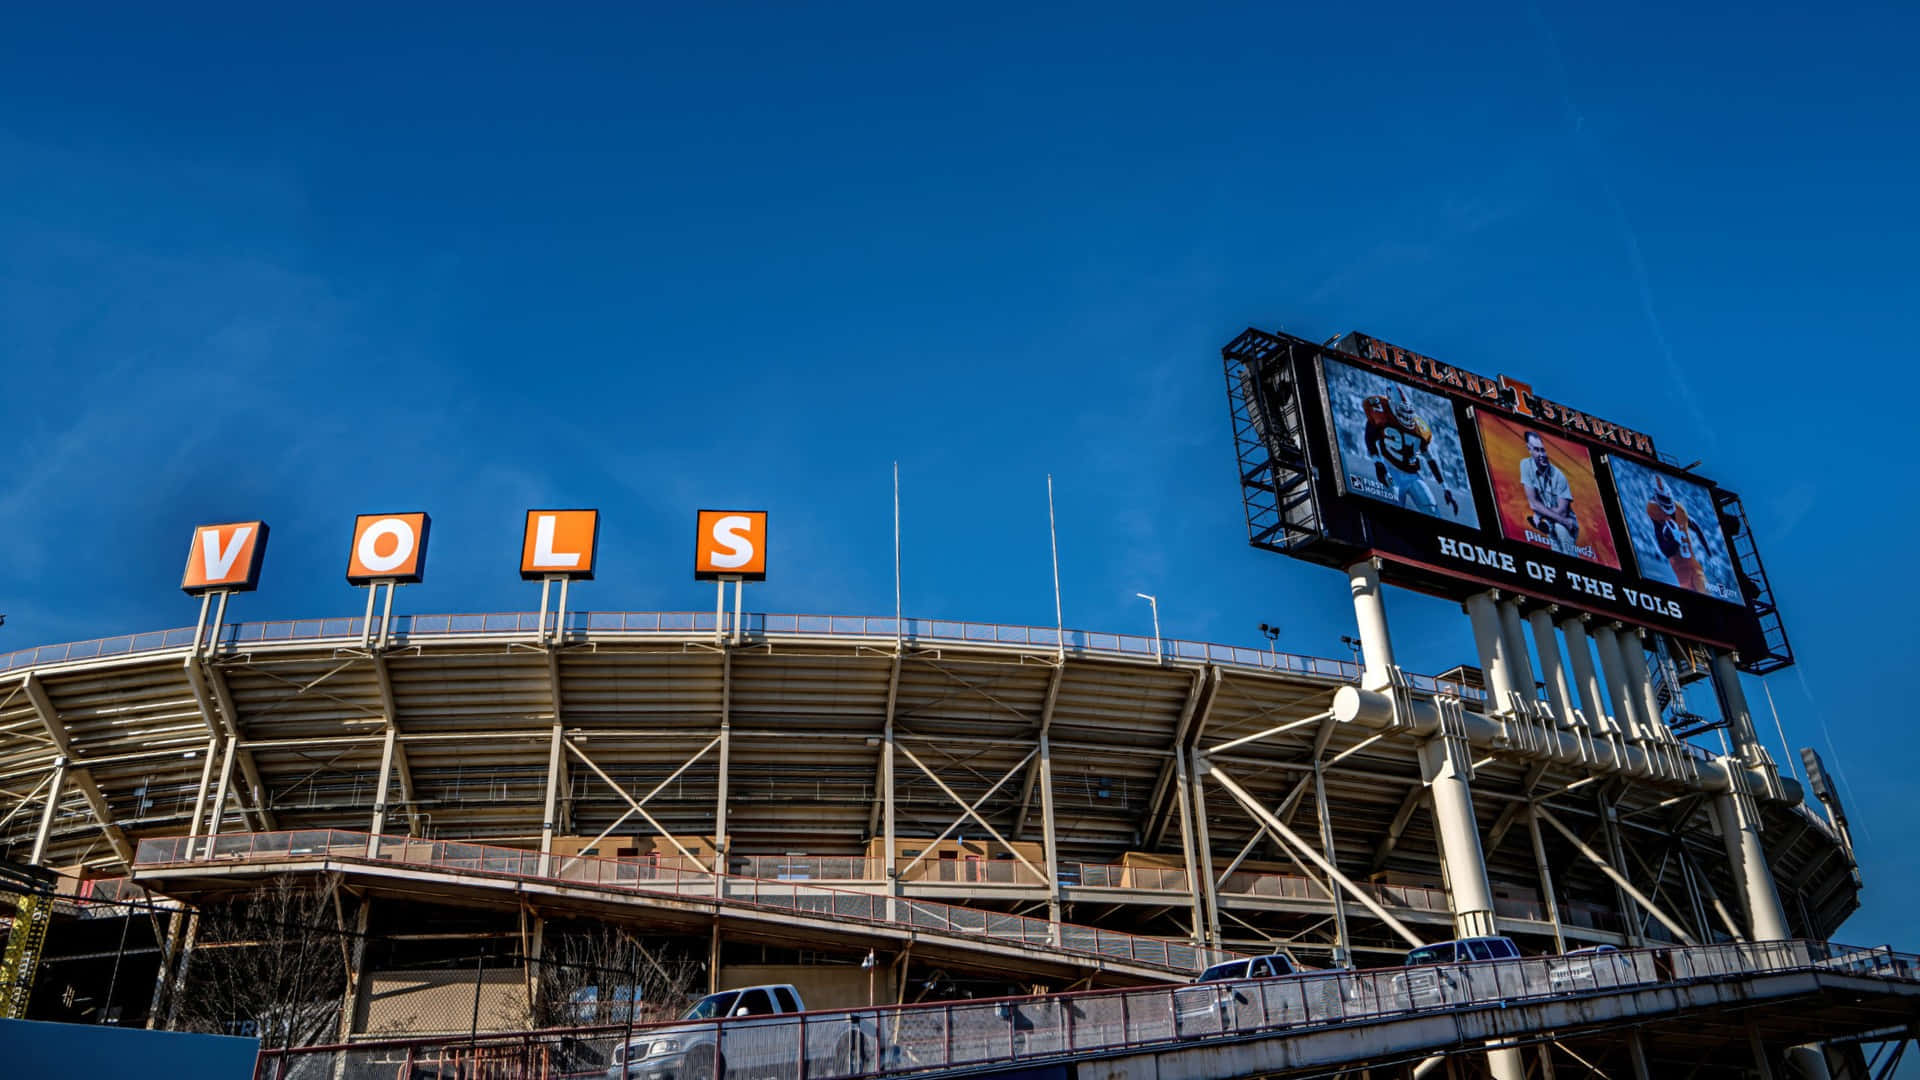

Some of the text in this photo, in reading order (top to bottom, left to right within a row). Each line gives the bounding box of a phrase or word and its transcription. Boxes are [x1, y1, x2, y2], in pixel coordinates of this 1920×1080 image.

[1369, 338, 1498, 399] NEYLAND
[1541, 399, 1653, 454] STADIUM
[1437, 536, 1682, 619] HOME OF THE VOLS
